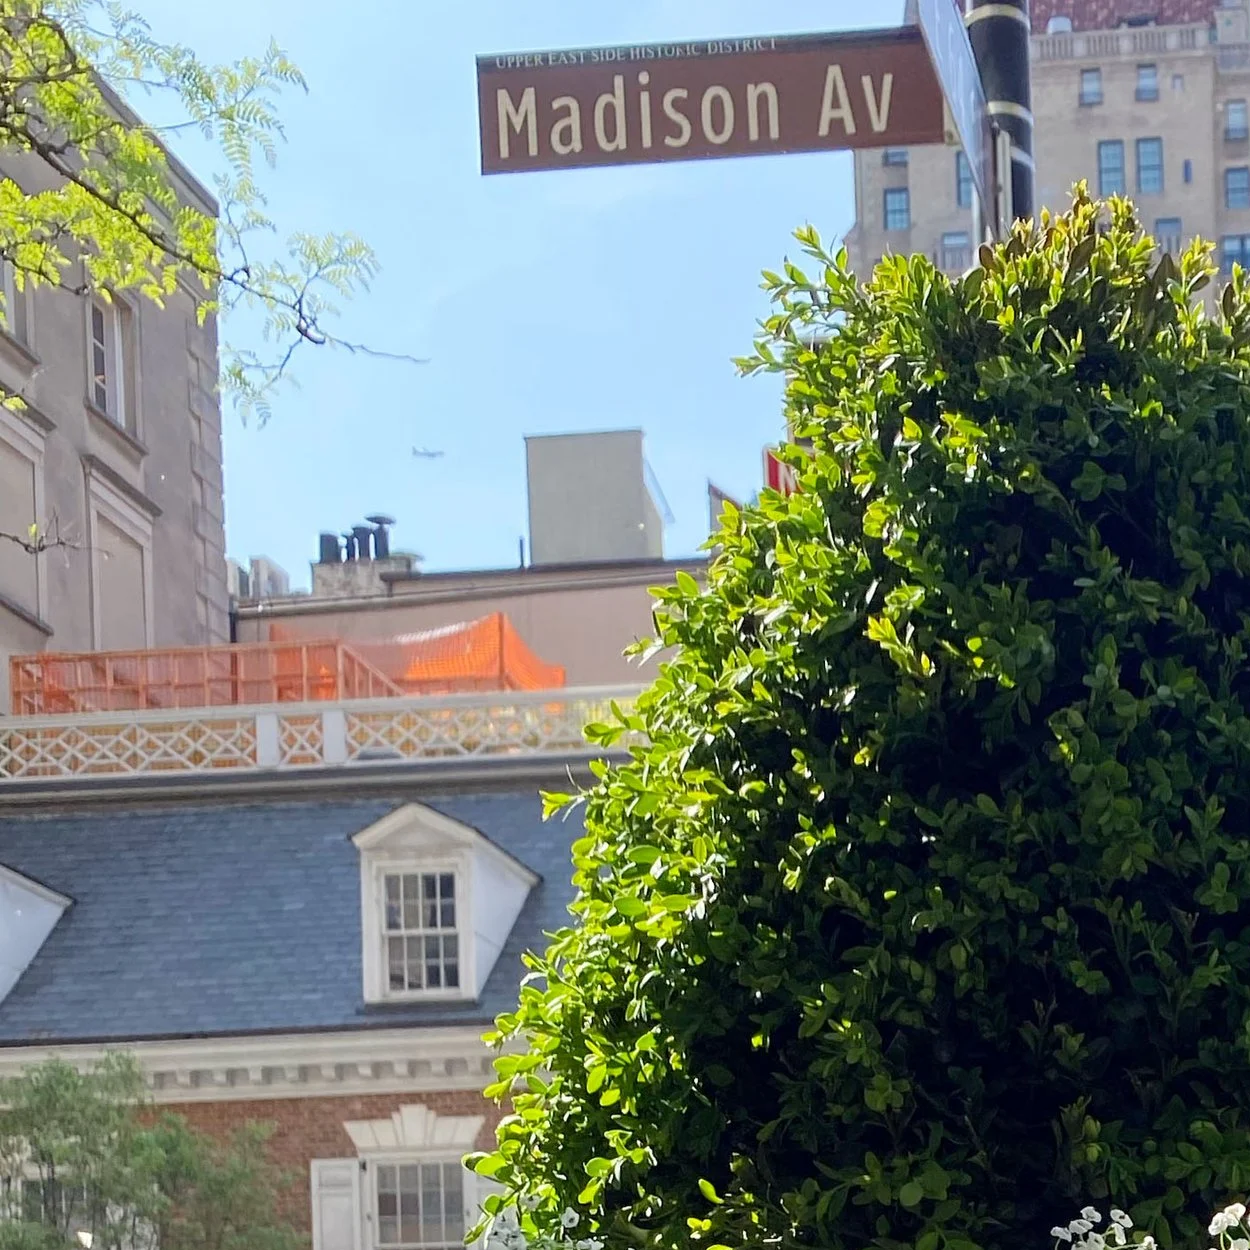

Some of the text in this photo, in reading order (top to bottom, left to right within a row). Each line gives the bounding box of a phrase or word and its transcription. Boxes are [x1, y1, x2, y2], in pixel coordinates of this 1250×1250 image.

[496, 37, 777, 69] UPPER EAST SIDE HISTORIC DISTRICT
[497, 71, 780, 158] Madison
[818, 63, 894, 137] Av
